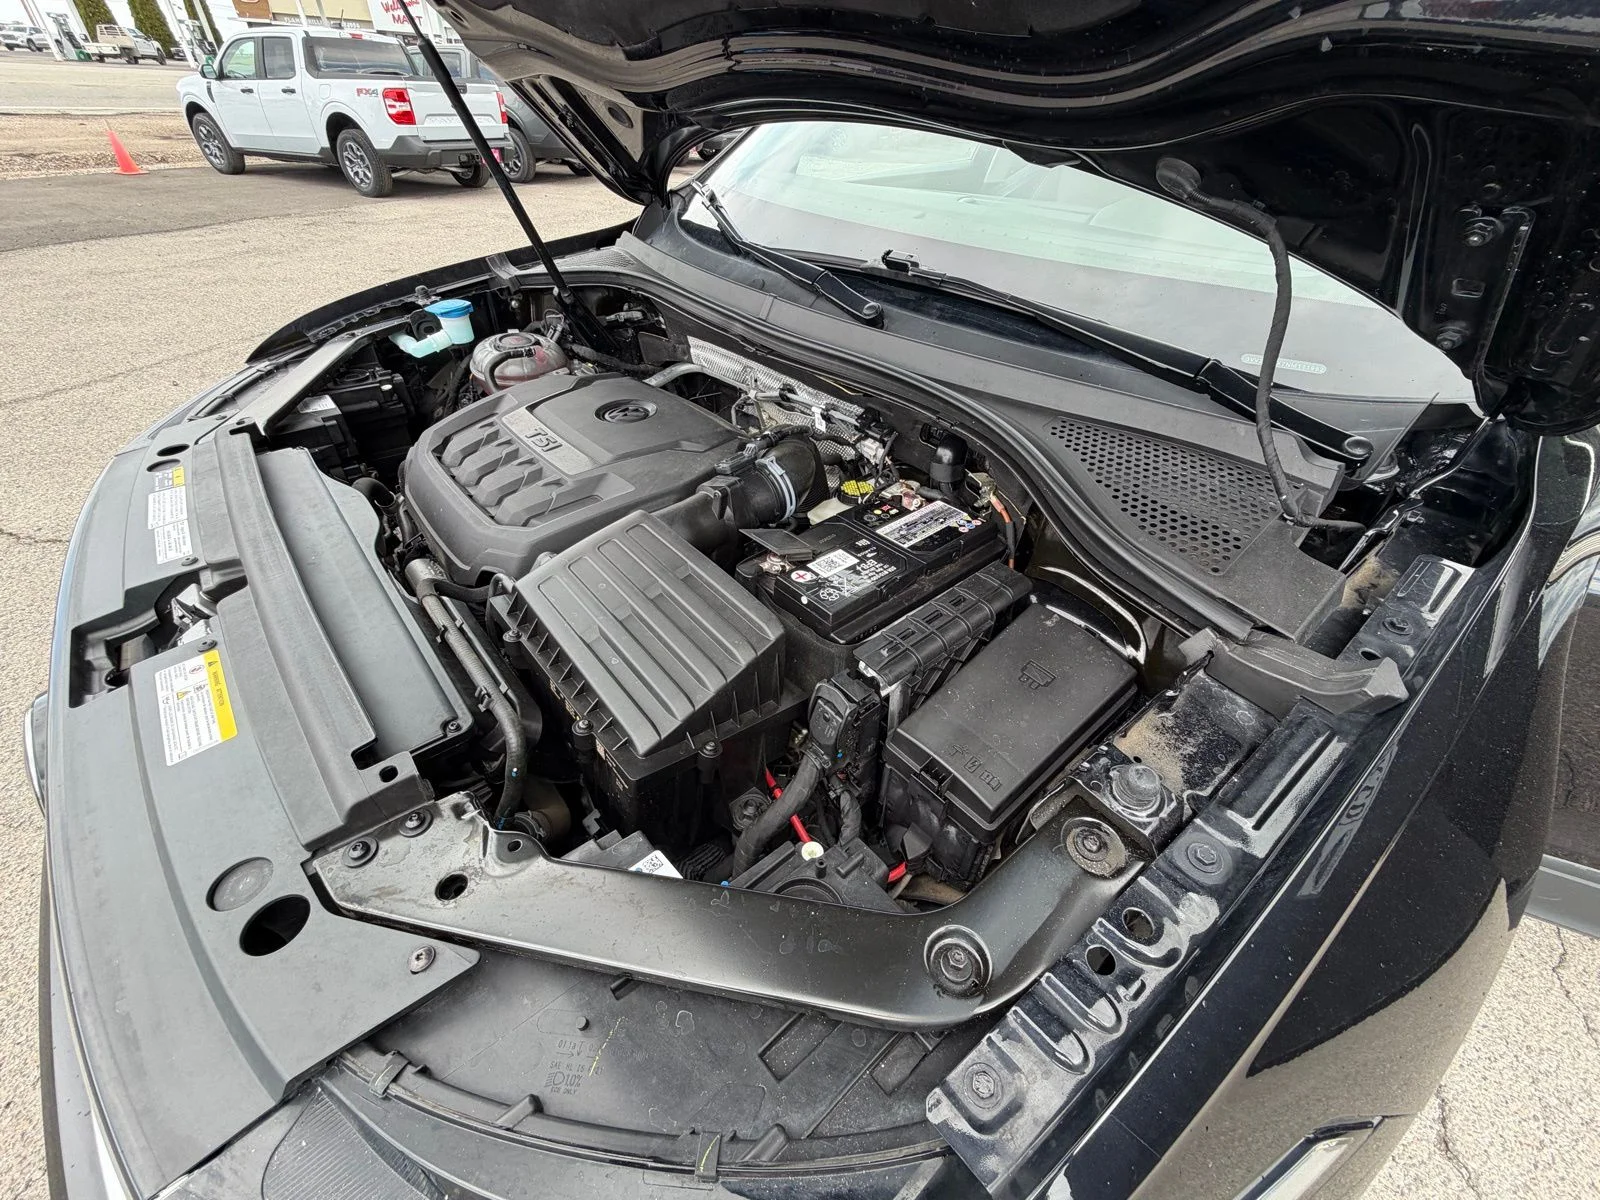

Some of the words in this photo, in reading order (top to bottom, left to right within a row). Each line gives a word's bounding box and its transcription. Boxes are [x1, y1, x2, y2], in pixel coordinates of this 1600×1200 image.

[392, 13, 423, 26] MAT
[356, 88, 379, 97] FX4
[525, 428, 563, 452] TSI
